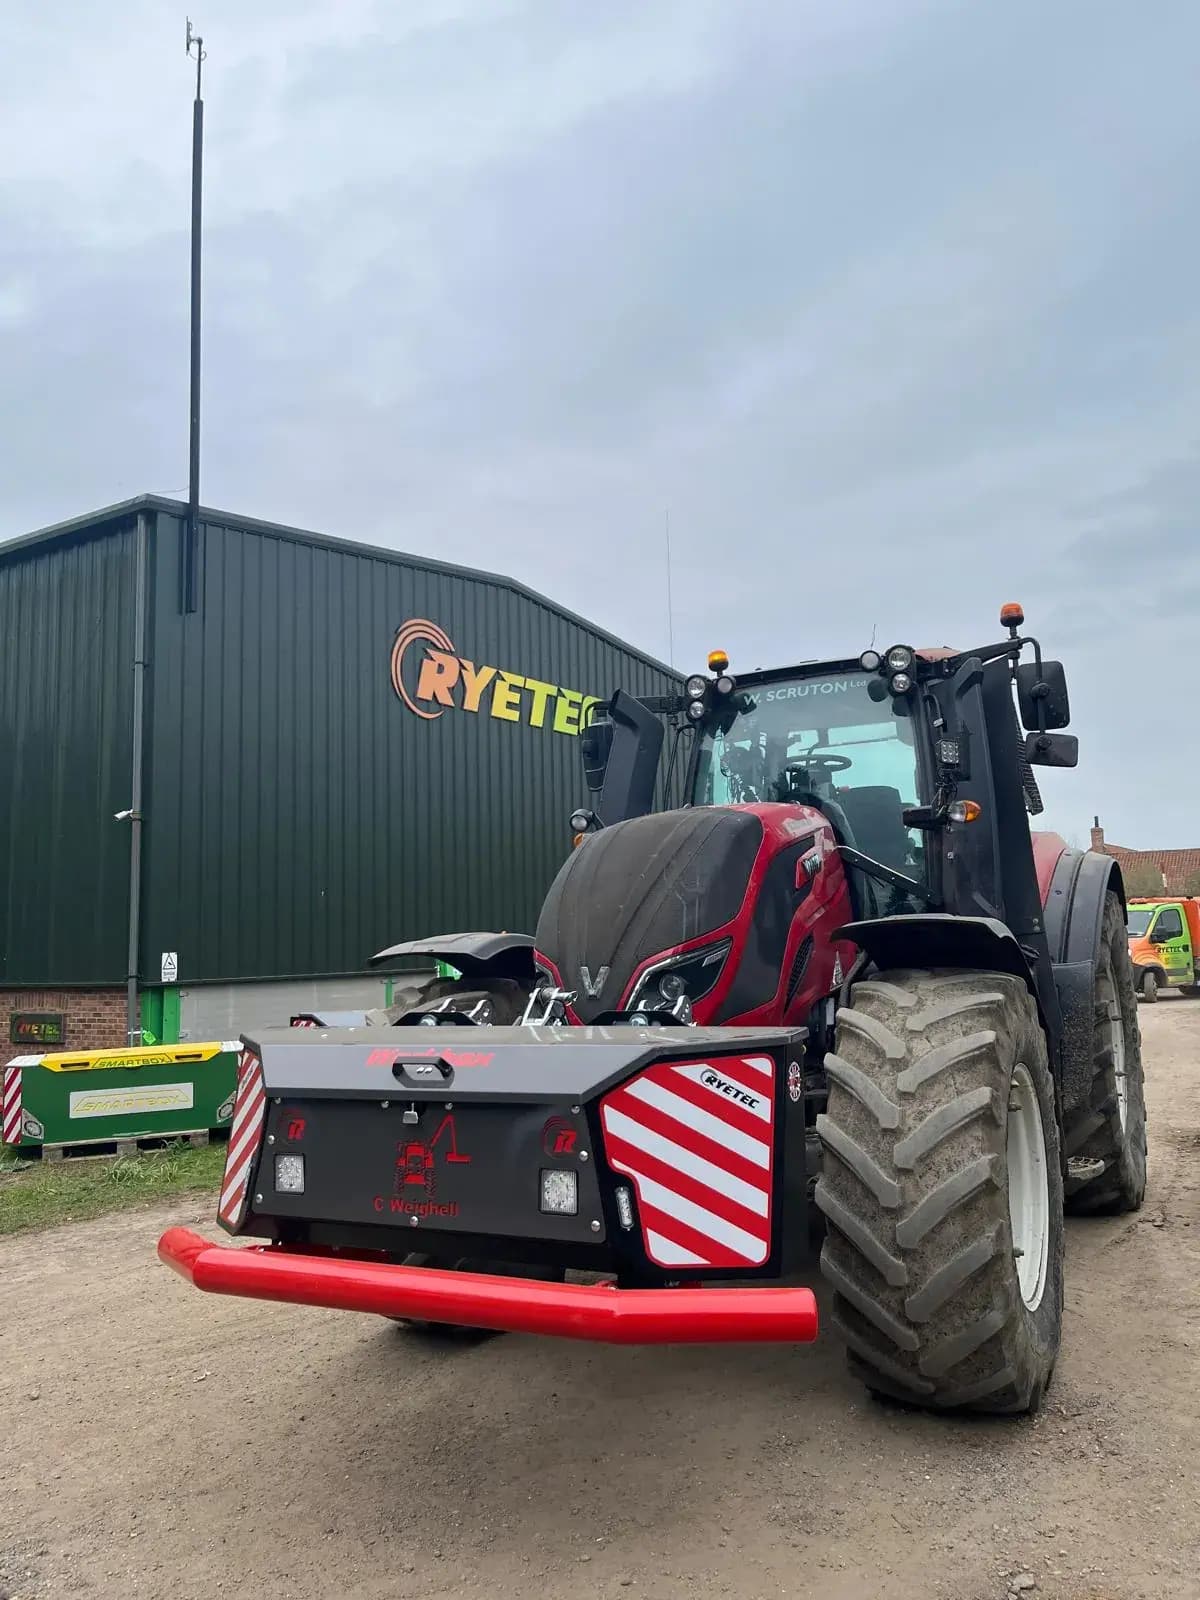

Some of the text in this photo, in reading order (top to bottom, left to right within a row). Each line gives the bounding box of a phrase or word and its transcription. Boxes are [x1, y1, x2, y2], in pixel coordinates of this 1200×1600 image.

[744, 679, 867, 705] W. SCRUTON Ltd
[1156, 946, 1182, 954] RYETEC
[99, 1057, 166, 1068] SMARTBOX
[705, 1074, 760, 1109] RYETEC
[373, 1196, 458, 1219] C Weighell
